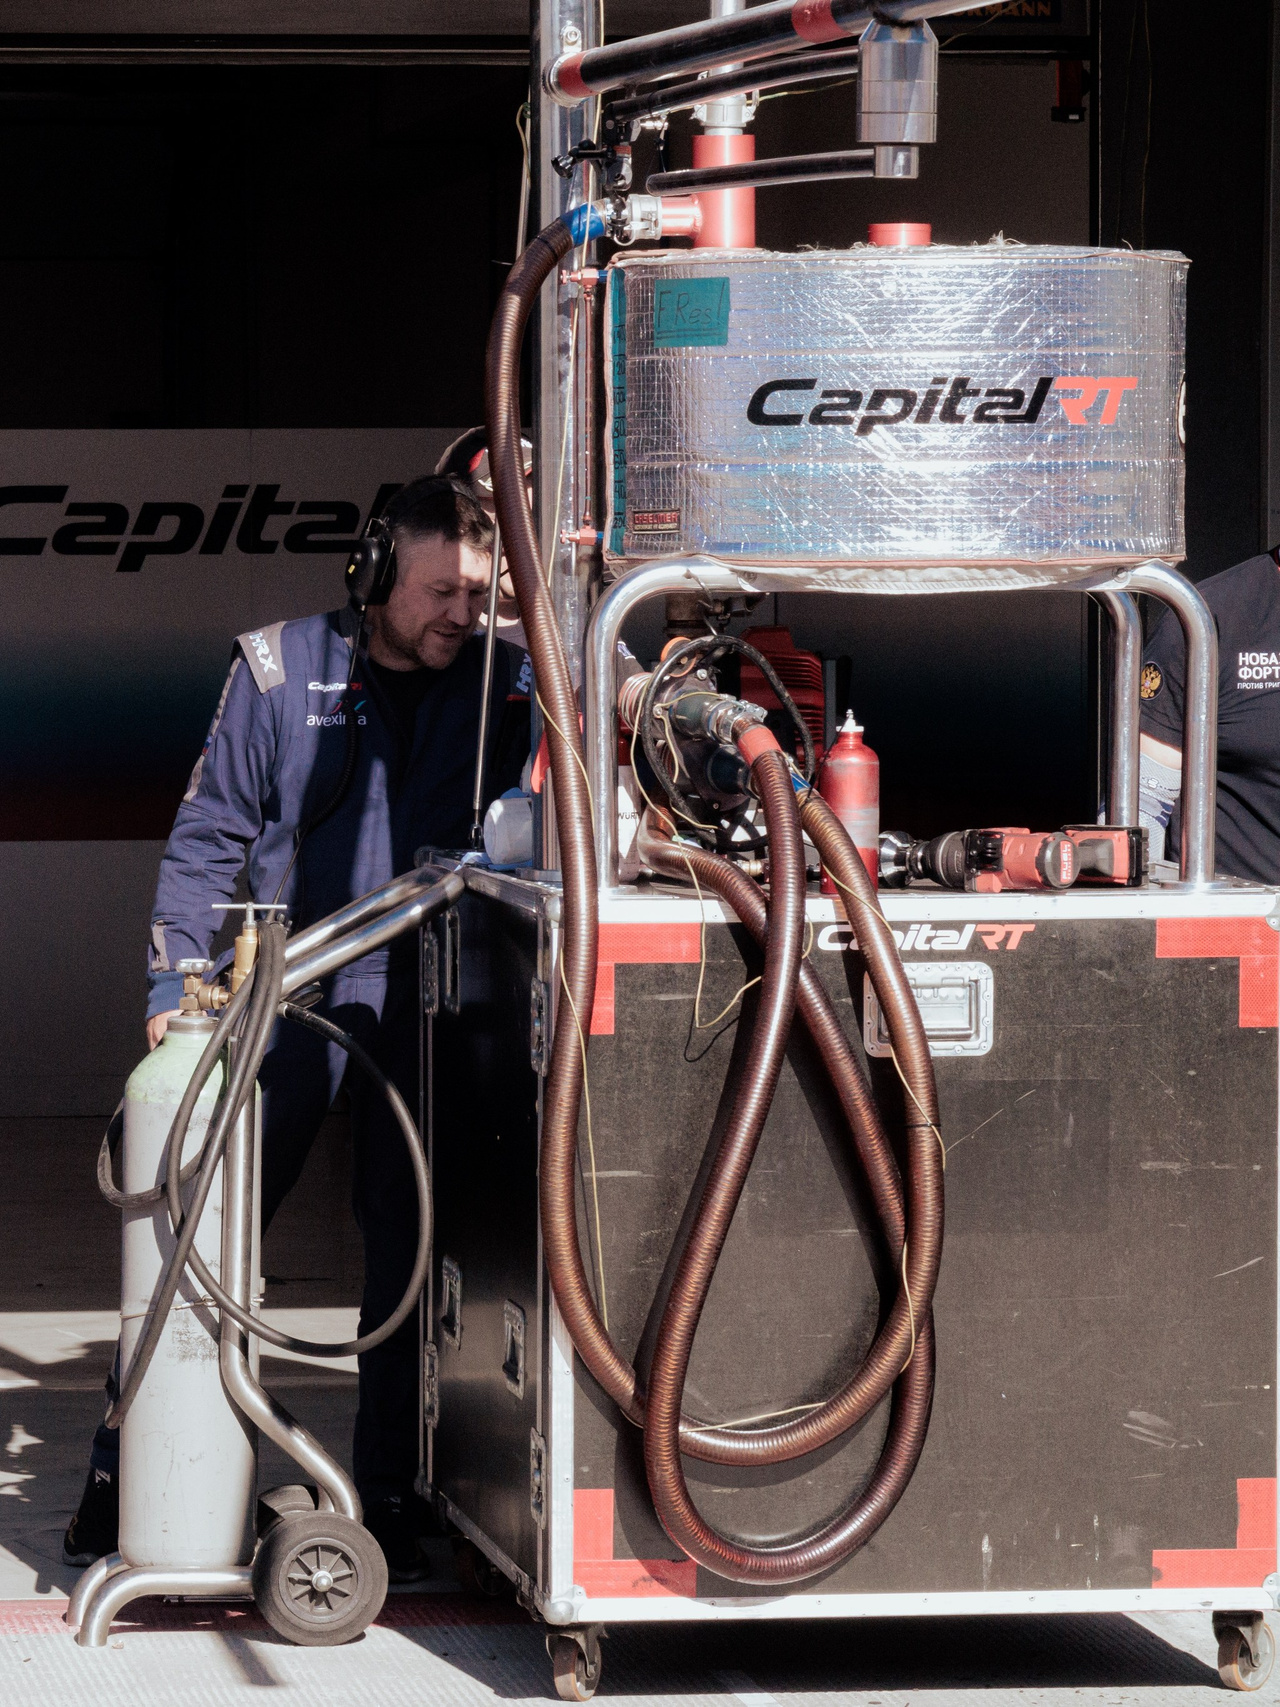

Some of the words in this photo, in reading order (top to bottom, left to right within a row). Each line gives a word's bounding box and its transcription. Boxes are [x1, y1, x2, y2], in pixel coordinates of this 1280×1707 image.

[249, 632, 278, 673] HRX
[1238, 652, 1280, 665] НОБА
[1237, 682, 1264, 690] ПРОТИВ
[817, 923, 1036, 950] CitalRT
